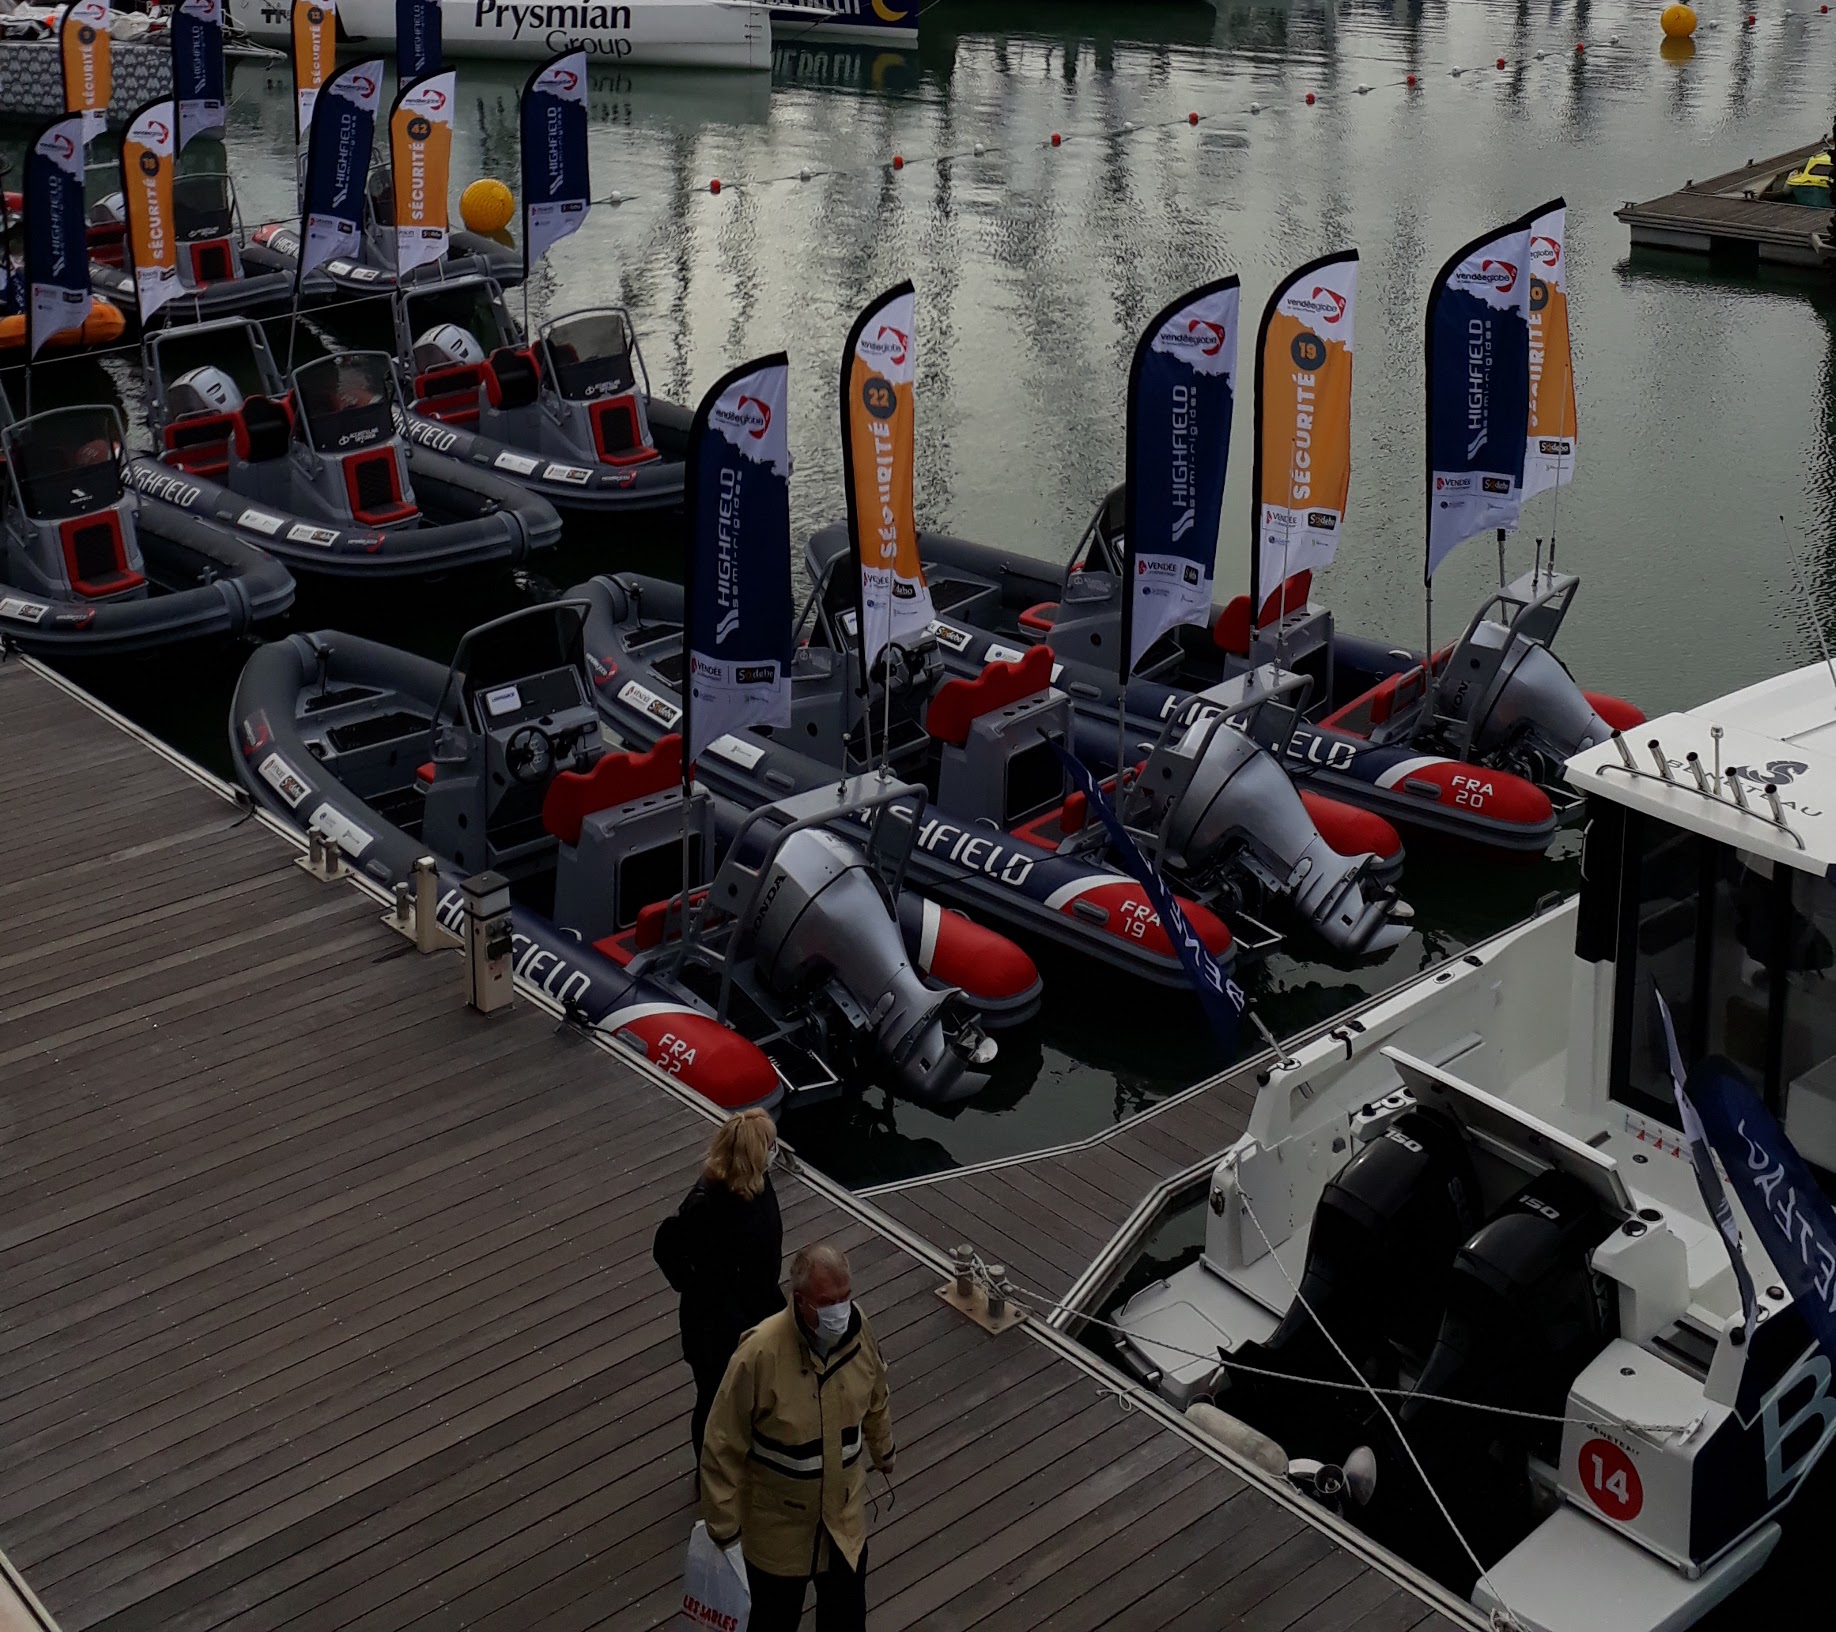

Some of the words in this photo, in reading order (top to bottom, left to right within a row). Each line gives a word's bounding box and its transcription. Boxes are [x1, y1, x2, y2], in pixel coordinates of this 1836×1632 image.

[545, 29, 633, 59] Group
[411, 123, 428, 135] 42
[547, 106, 557, 176] HIGHFIELD
[335, 113, 351, 189] HIGHFIELD
[408, 142, 425, 221] SÉCURITÉ
[143, 178, 164, 260] SÉCURITÉ
[1456, 272, 1510, 284] vendéeglobe
[1287, 297, 1338, 313] vendéeglobe
[1299, 341, 1317, 359] 19
[1468, 318, 1484, 430] HIGHFIELD
[1482, 320, 1492, 429] semi-rigides
[868, 387, 890, 409] 22
[1172, 384, 1188, 507] HIGHFIELD
[1189, 385, 1197, 509] semi-rigides
[1290, 372, 1316, 501] SÉCURITÉ
[717, 467, 735, 608] HIGHFIELD
[731, 470, 743, 608] semi-rigides
[1147, 561, 1177, 573] VENDÉE
[936, 626, 964, 643] Sodebo
[738, 669, 775, 681] Sodebo
[1452, 774, 1494, 797] FRA
[1455, 789, 1485, 809] 20
[1120, 899, 1161, 928] FRA
[1124, 917, 1146, 939] 19
[655, 1052, 682, 1075] 22
[657, 1032, 698, 1066] FRA
[1384, 1128, 1424, 1153] 150
[1518, 1194, 1561, 1220] 150
[1591, 1453, 1630, 1505] 14
[682, 1594, 700, 1615] LES
[700, 1603, 739, 1632] SABLES
